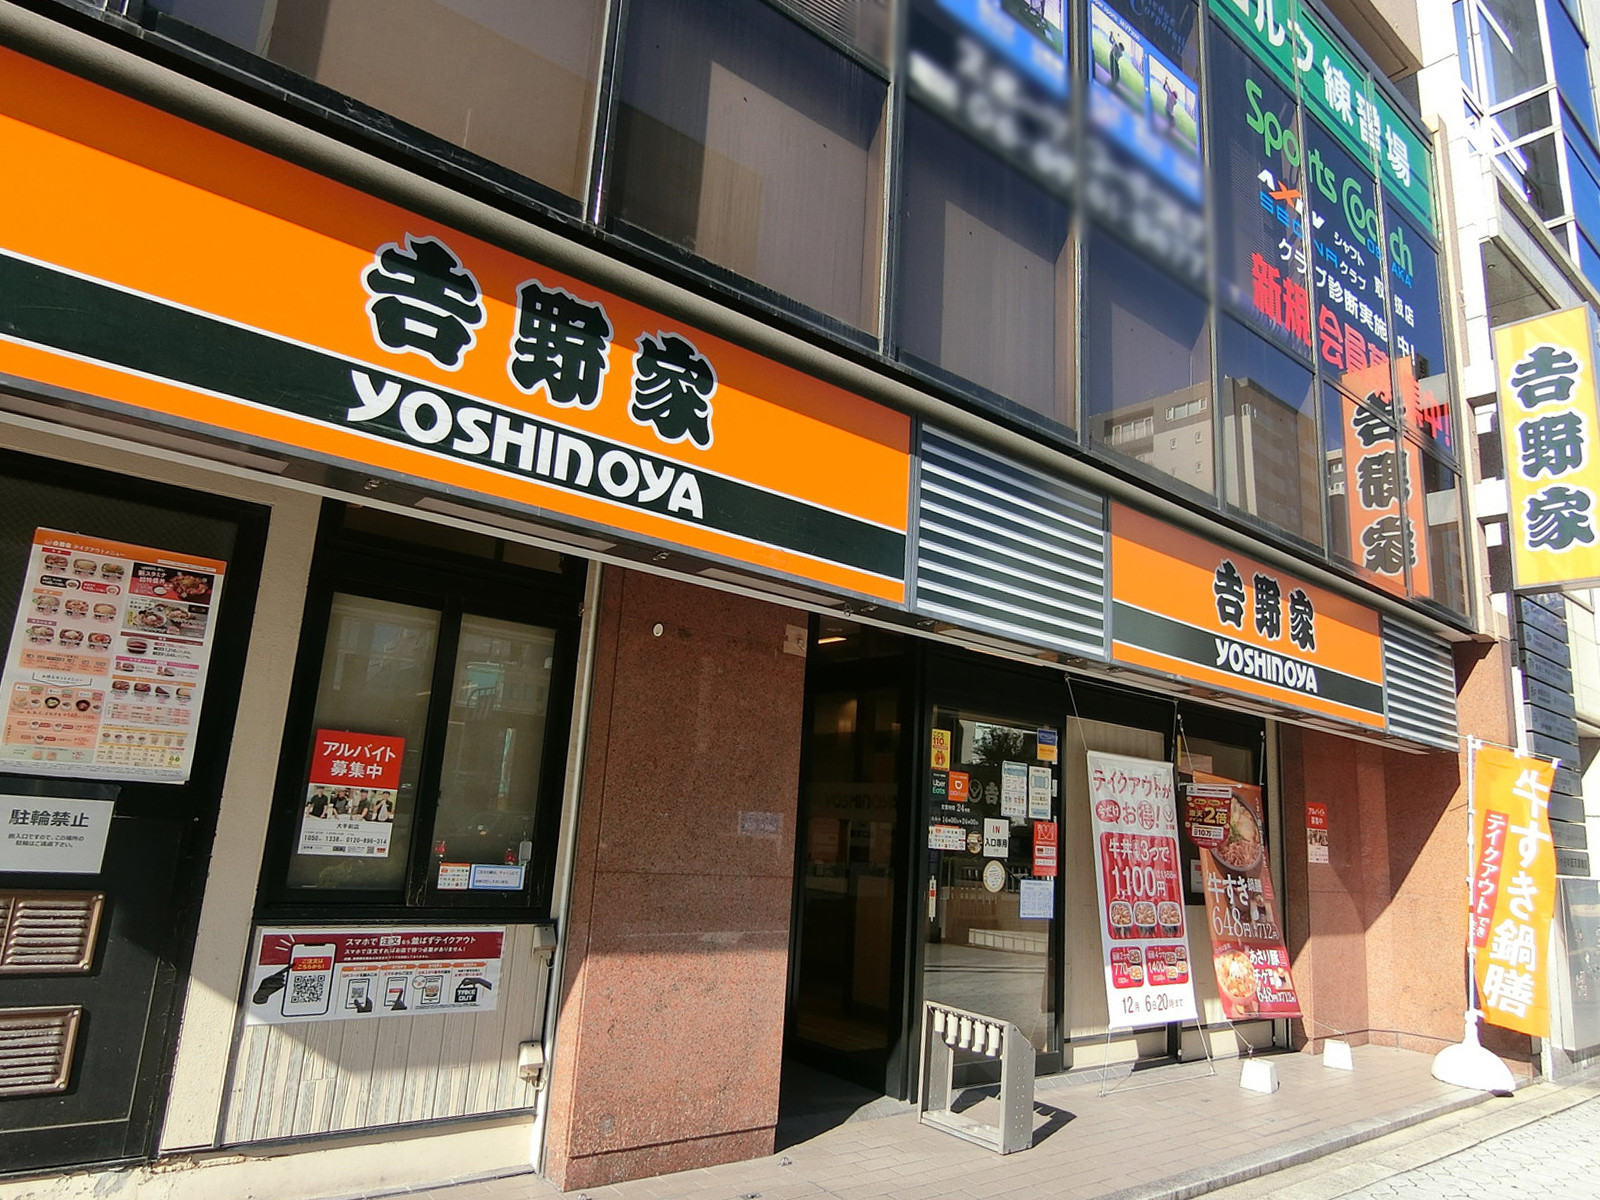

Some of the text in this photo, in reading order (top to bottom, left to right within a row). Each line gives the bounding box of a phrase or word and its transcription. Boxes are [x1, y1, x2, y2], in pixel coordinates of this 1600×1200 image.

[364, 233, 716, 449] 吉野家
[346, 369, 704, 520] YOSHINOYA
[1511, 345, 1595, 551] 吉野家
[1213, 558, 1317, 654] 吉野家
[1214, 638, 1318, 694] YOSHINOYA
[322, 741, 396, 763] アルバイト
[330, 759, 383, 780] 募集中
[932, 779, 946, 788] Uber
[1093, 769, 1172, 799] テイクアウトが
[932, 787, 946, 795] Eats
[8, 808, 90, 828] 駐輪禁止
[992, 825, 1001, 834] IN
[1481, 768, 1551, 1019] 牛すき鍋膳
